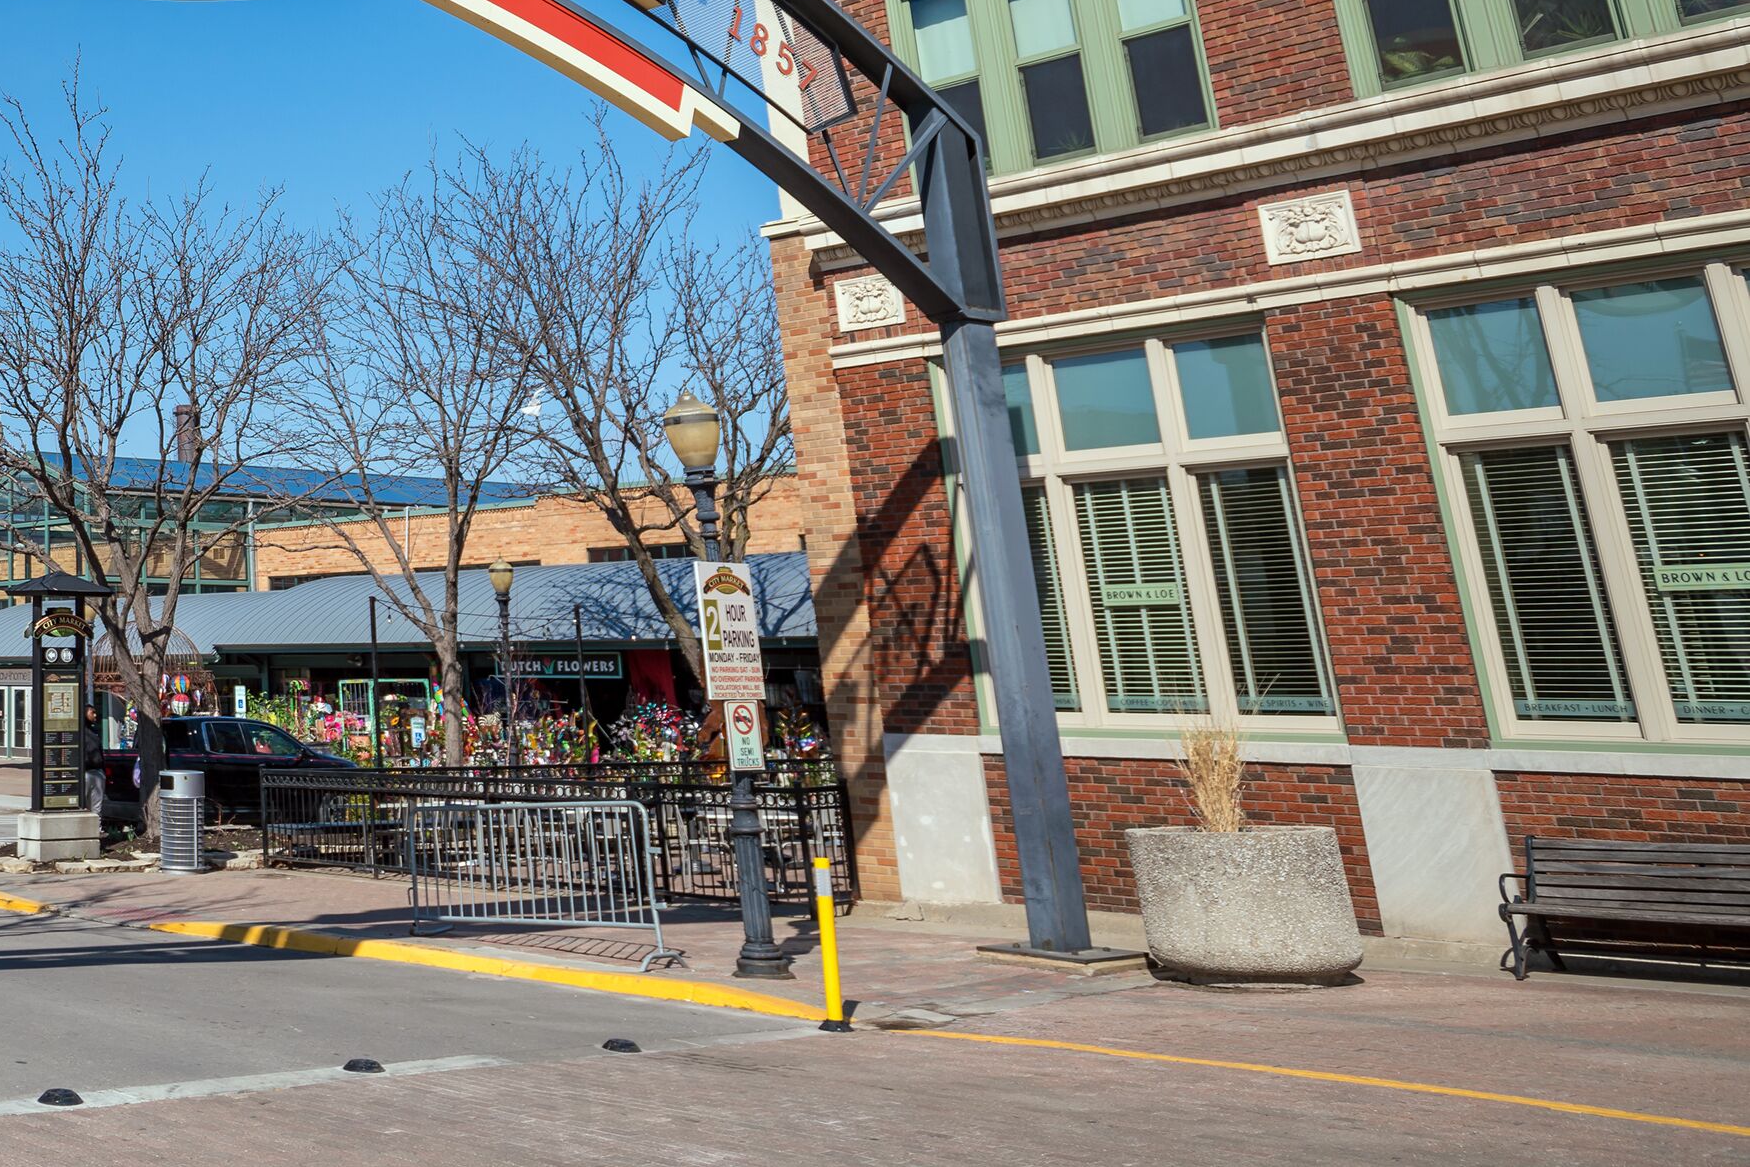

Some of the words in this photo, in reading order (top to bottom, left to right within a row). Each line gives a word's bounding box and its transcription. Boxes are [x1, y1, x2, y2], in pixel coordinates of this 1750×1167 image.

[728, 6, 818, 92] 1857
[1662, 572, 1716, 583] BROWN
[1722, 572, 1730, 581] &
[1106, 589, 1143, 600] BROWN
[1146, 589, 1152, 599] &
[1155, 588, 1175, 599] LOE
[725, 604, 747, 621] HOUR
[42, 618, 56, 630] CITY
[59, 617, 86, 630] MARKET
[706, 606, 721, 641] 2
[723, 630, 755, 648] PARKING
[709, 653, 735, 663] MONDAY
[740, 653, 761, 662] FRIDAY
[557, 660, 615, 672] FLOWERS
[1120, 699, 1151, 707] COFFEE
[1266, 700, 1296, 708] SPIRITS
[1307, 700, 1329, 708] WINE
[1524, 703, 1581, 712] BREAKFAST
[1592, 704, 1628, 713] LUNCH
[1683, 705, 1726, 714] DINNER
[741, 737, 750, 745] NO
[740, 747, 754, 756] SEMI
[737, 758, 760, 767] TRUCKS
